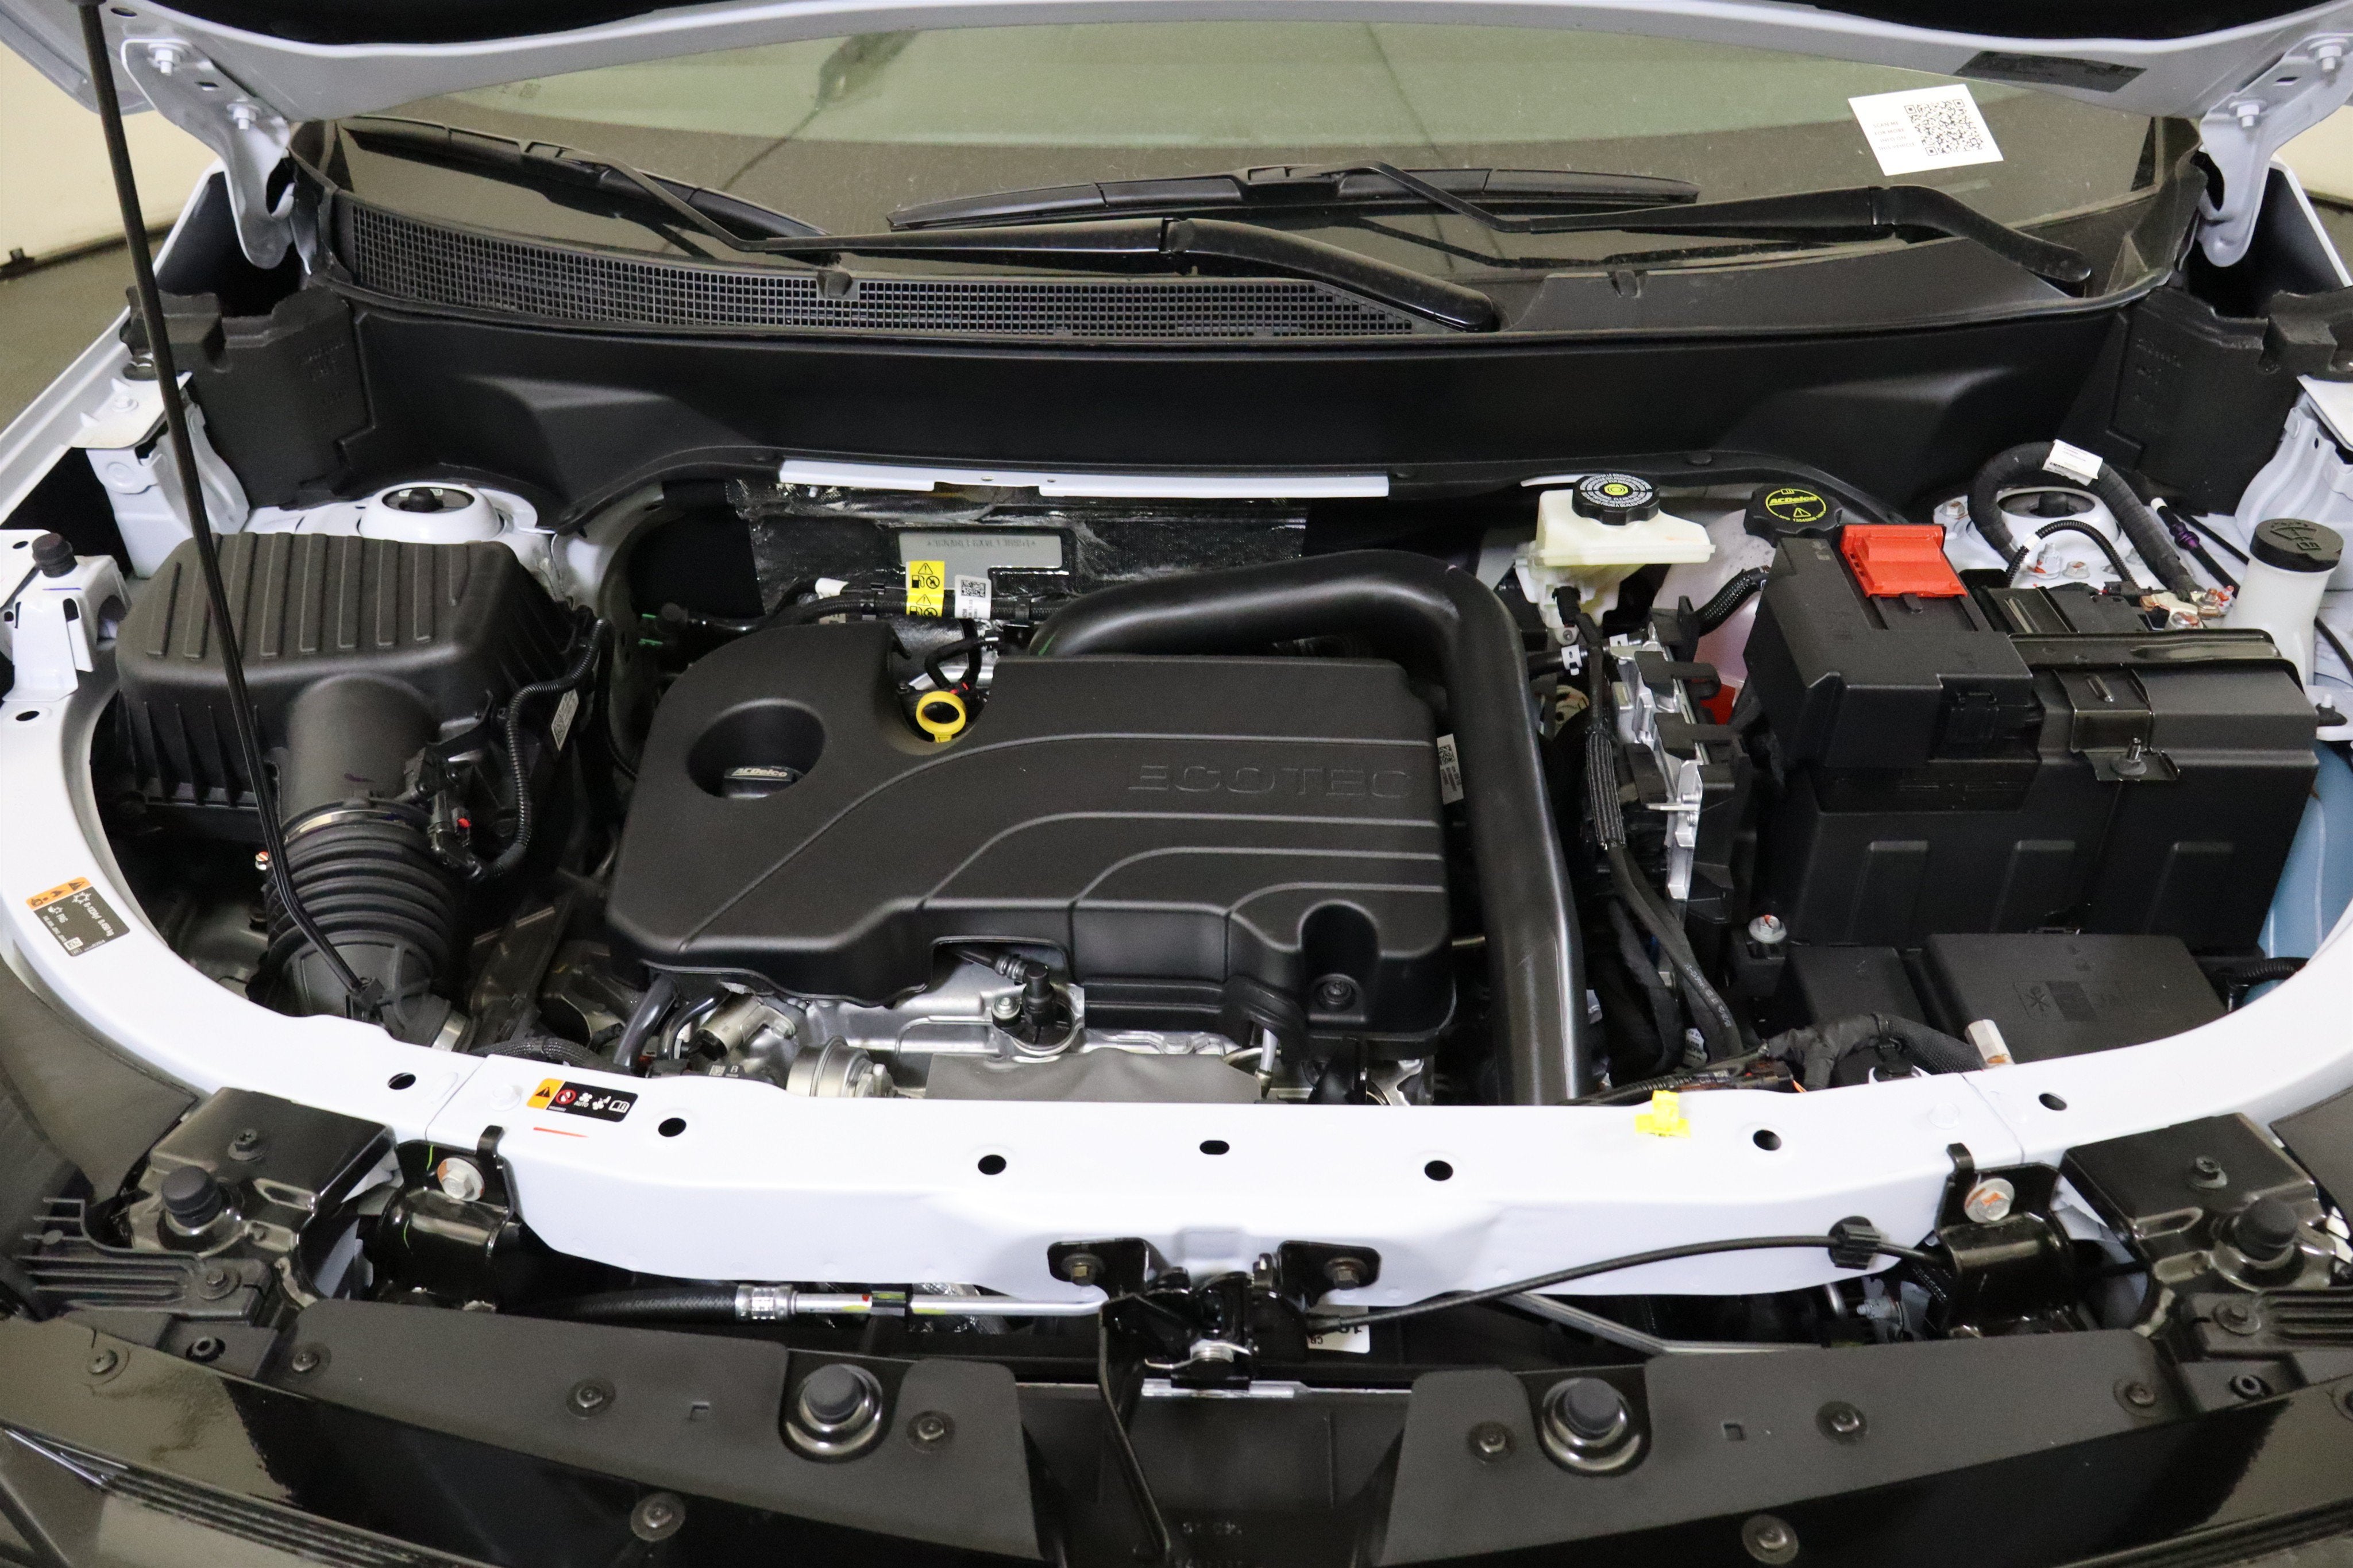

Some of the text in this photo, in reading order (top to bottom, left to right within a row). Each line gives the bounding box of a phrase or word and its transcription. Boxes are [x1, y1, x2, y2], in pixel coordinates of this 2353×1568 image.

[1769, 496, 1818, 505] ACDelco
[731, 768, 788, 777] ACDelco
[1128, 766, 1412, 798] ECOTEC
